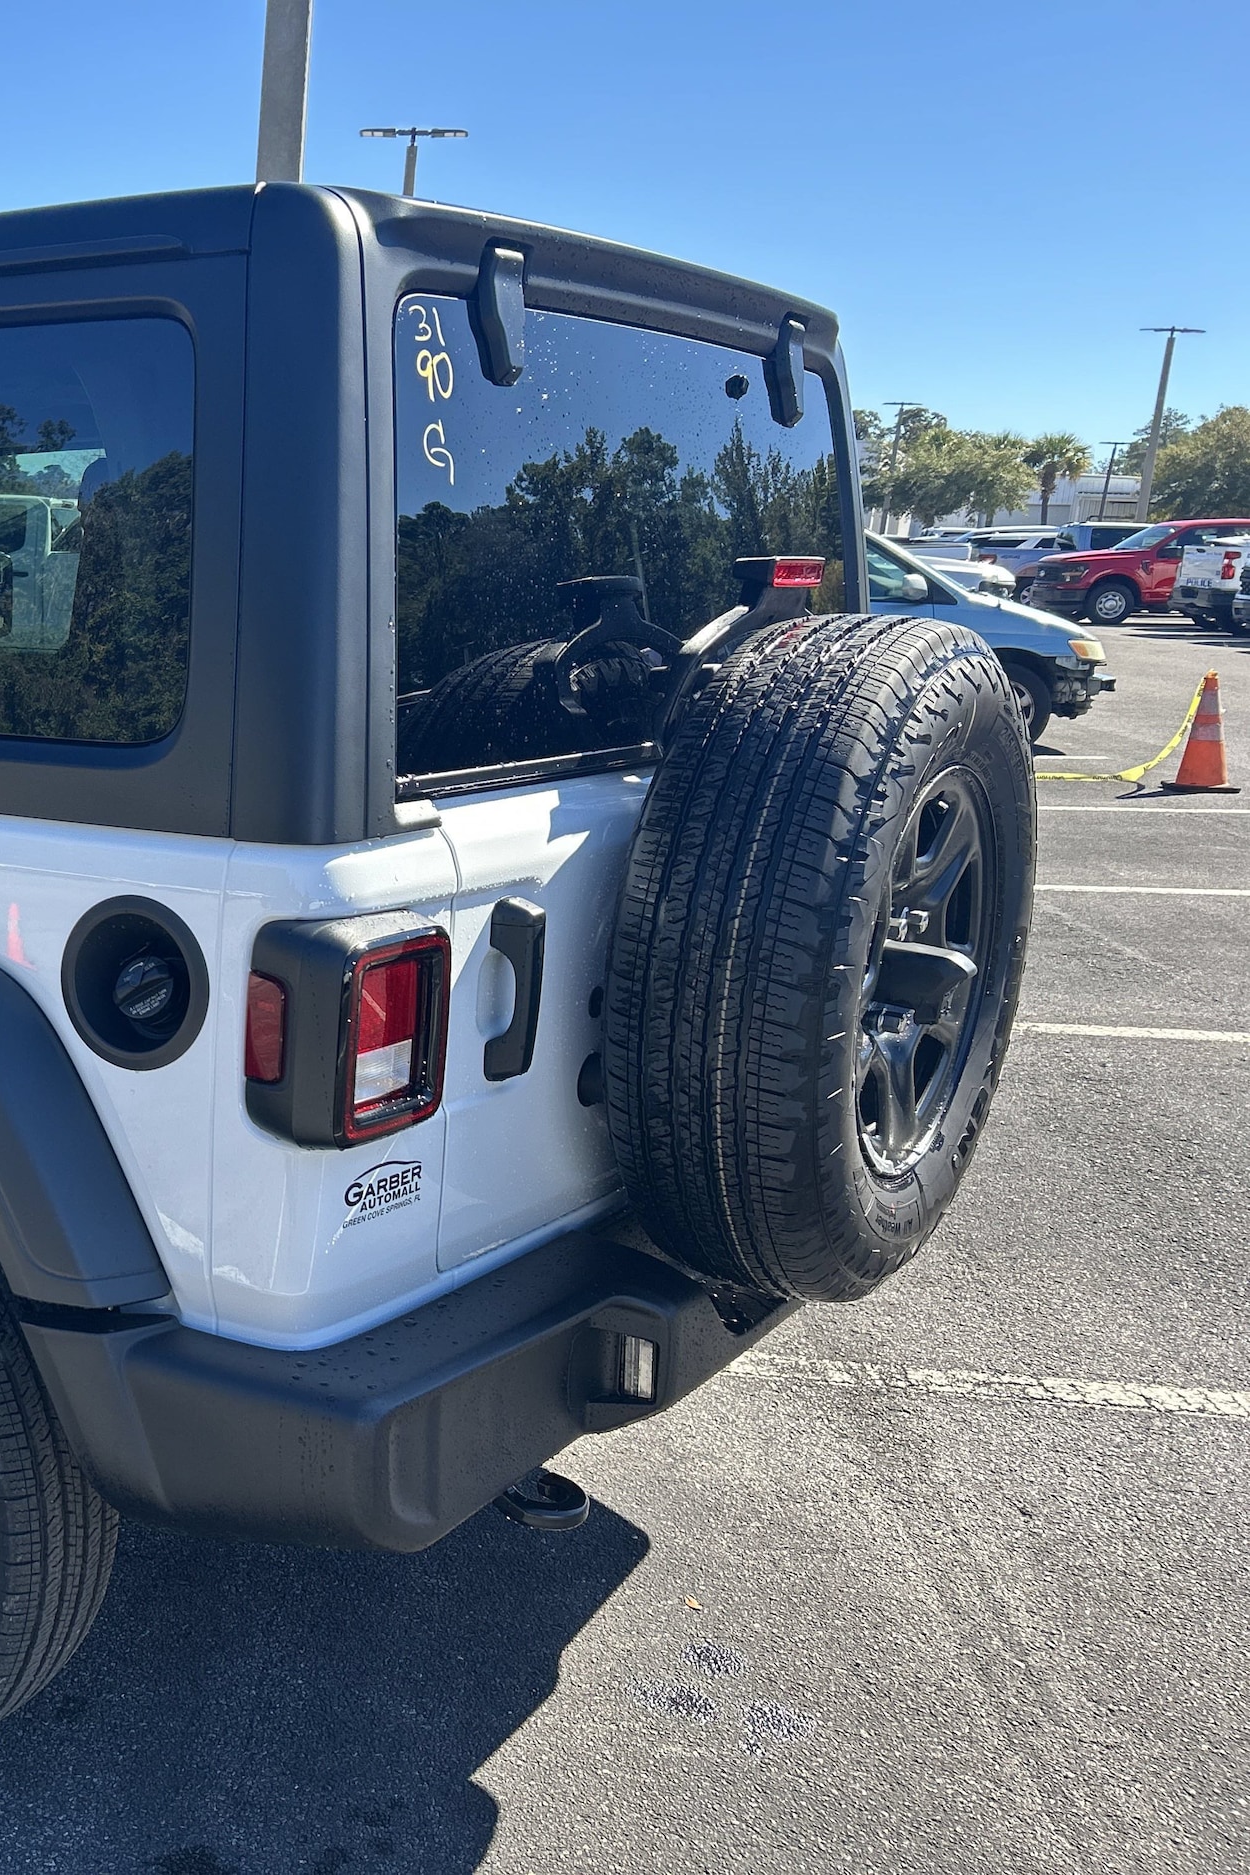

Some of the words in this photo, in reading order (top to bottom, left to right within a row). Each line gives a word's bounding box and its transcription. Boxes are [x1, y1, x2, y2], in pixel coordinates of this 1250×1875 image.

[408, 305, 446, 347] 31
[416, 349, 455, 403] 90
[344, 1164, 423, 1208] GARBER
[359, 1181, 421, 1213] AUTOMALL
[342, 1215, 367, 1229] GREEN
[367, 1207, 386, 1221] COVE
[413, 1193, 422, 1203] FL
